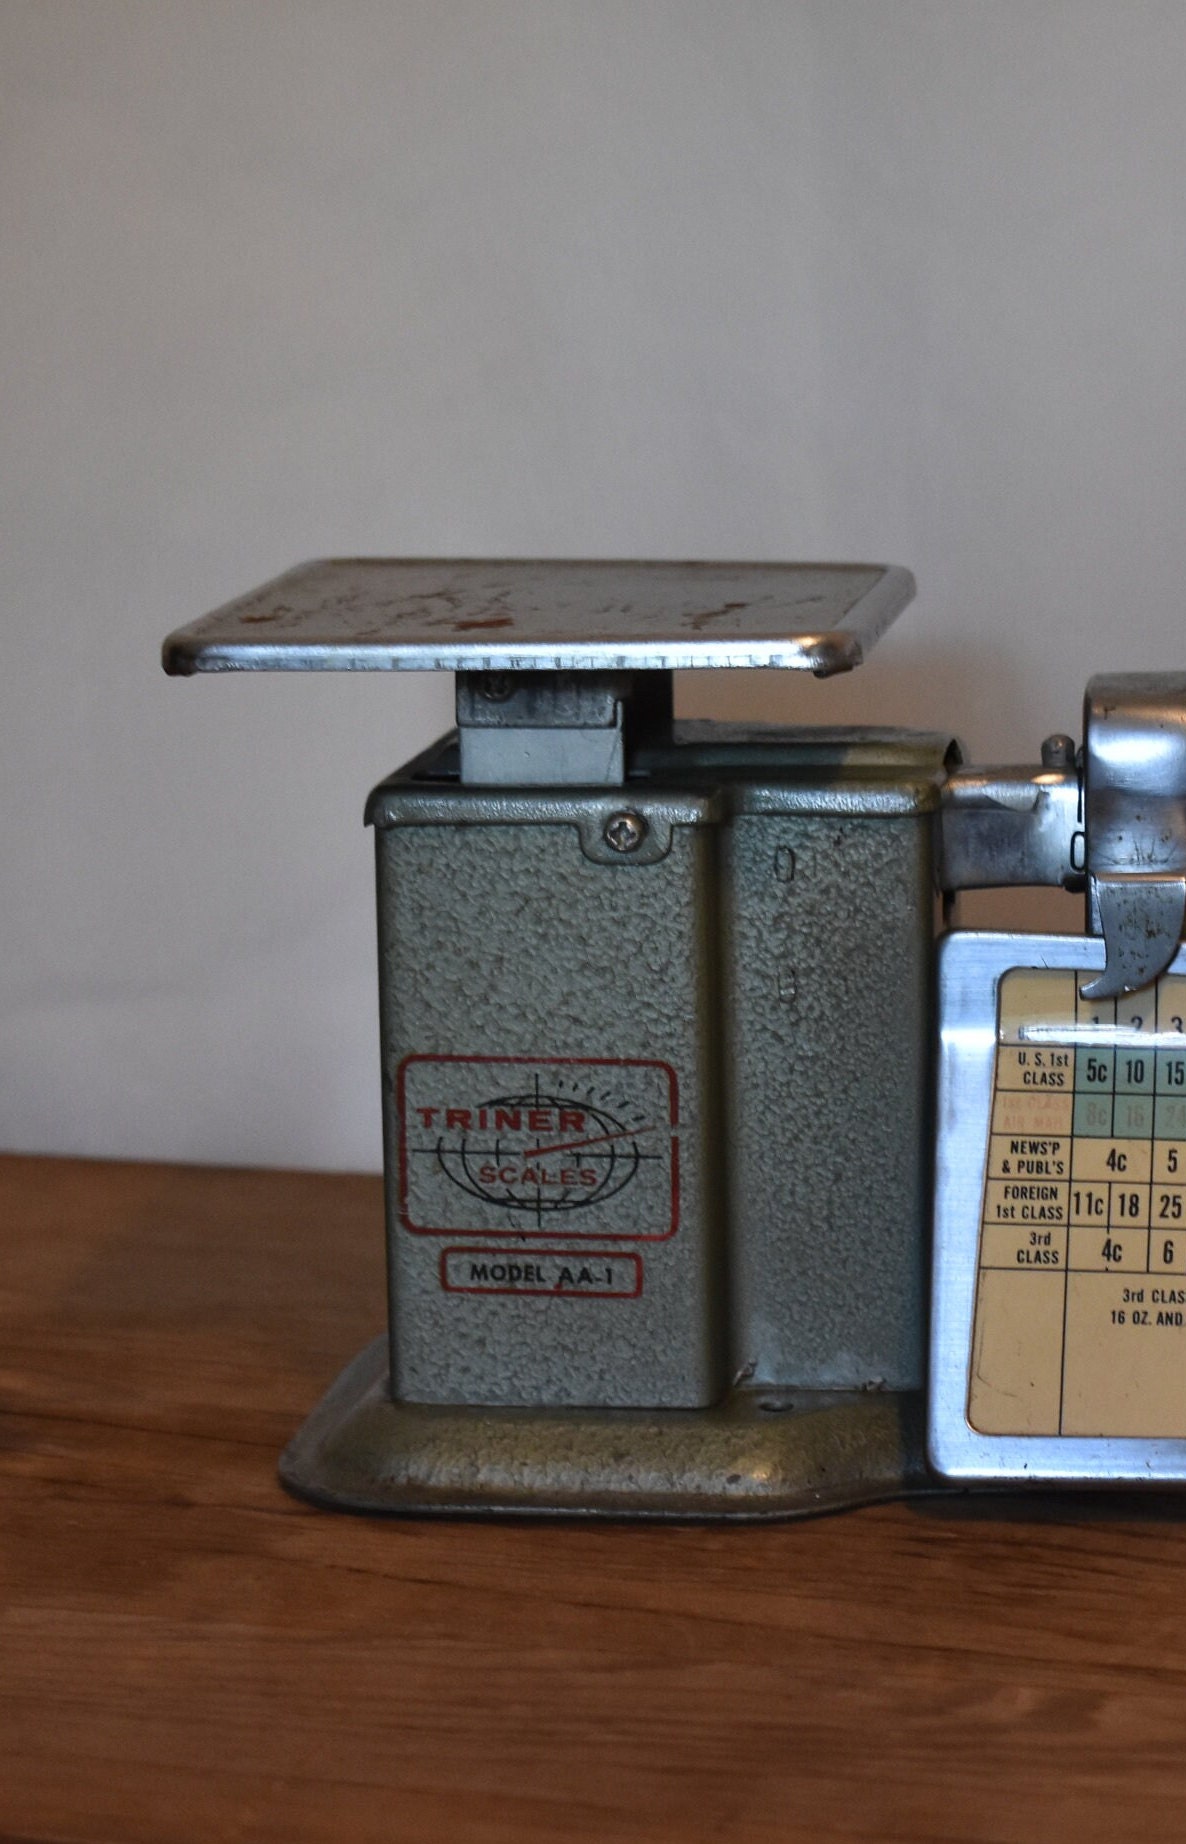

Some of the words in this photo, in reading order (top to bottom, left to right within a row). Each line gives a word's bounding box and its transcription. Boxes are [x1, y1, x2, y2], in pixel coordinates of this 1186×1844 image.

[1050, 1053, 1069, 1067] 1st
[1023, 1071, 1065, 1087] CLASS
[1086, 1058, 1107, 1083] 5c
[1125, 1060, 1145, 1084] 10
[1166, 1061, 1185, 1086] 15
[415, 1107, 587, 1133] TRINER
[1010, 1141, 1060, 1155] NEWS'P
[1001, 1160, 1011, 1174] &
[1017, 1160, 1064, 1175] PUBL'S
[1106, 1149, 1127, 1172] 4c
[1167, 1151, 1178, 1174] 5
[478, 1166, 598, 1187] SCALES
[1004, 1186, 1058, 1200] FOREIGN
[996, 1205, 1015, 1219] 1st
[1021, 1206, 1064, 1220] CLASS
[1073, 1192, 1104, 1217] 11c
[1119, 1194, 1140, 1218] 18
[1159, 1195, 1182, 1219] 25
[1029, 1231, 1051, 1246] 3rd
[1016, 1249, 1060, 1265] CLASS
[1101, 1239, 1122, 1262] 4c
[470, 1264, 546, 1283] MODEL
[558, 1267, 613, 1285] AA-1
[1122, 1288, 1145, 1304] 3rd
[1110, 1310, 1125, 1325] 16
[1156, 1312, 1183, 1327] AND
